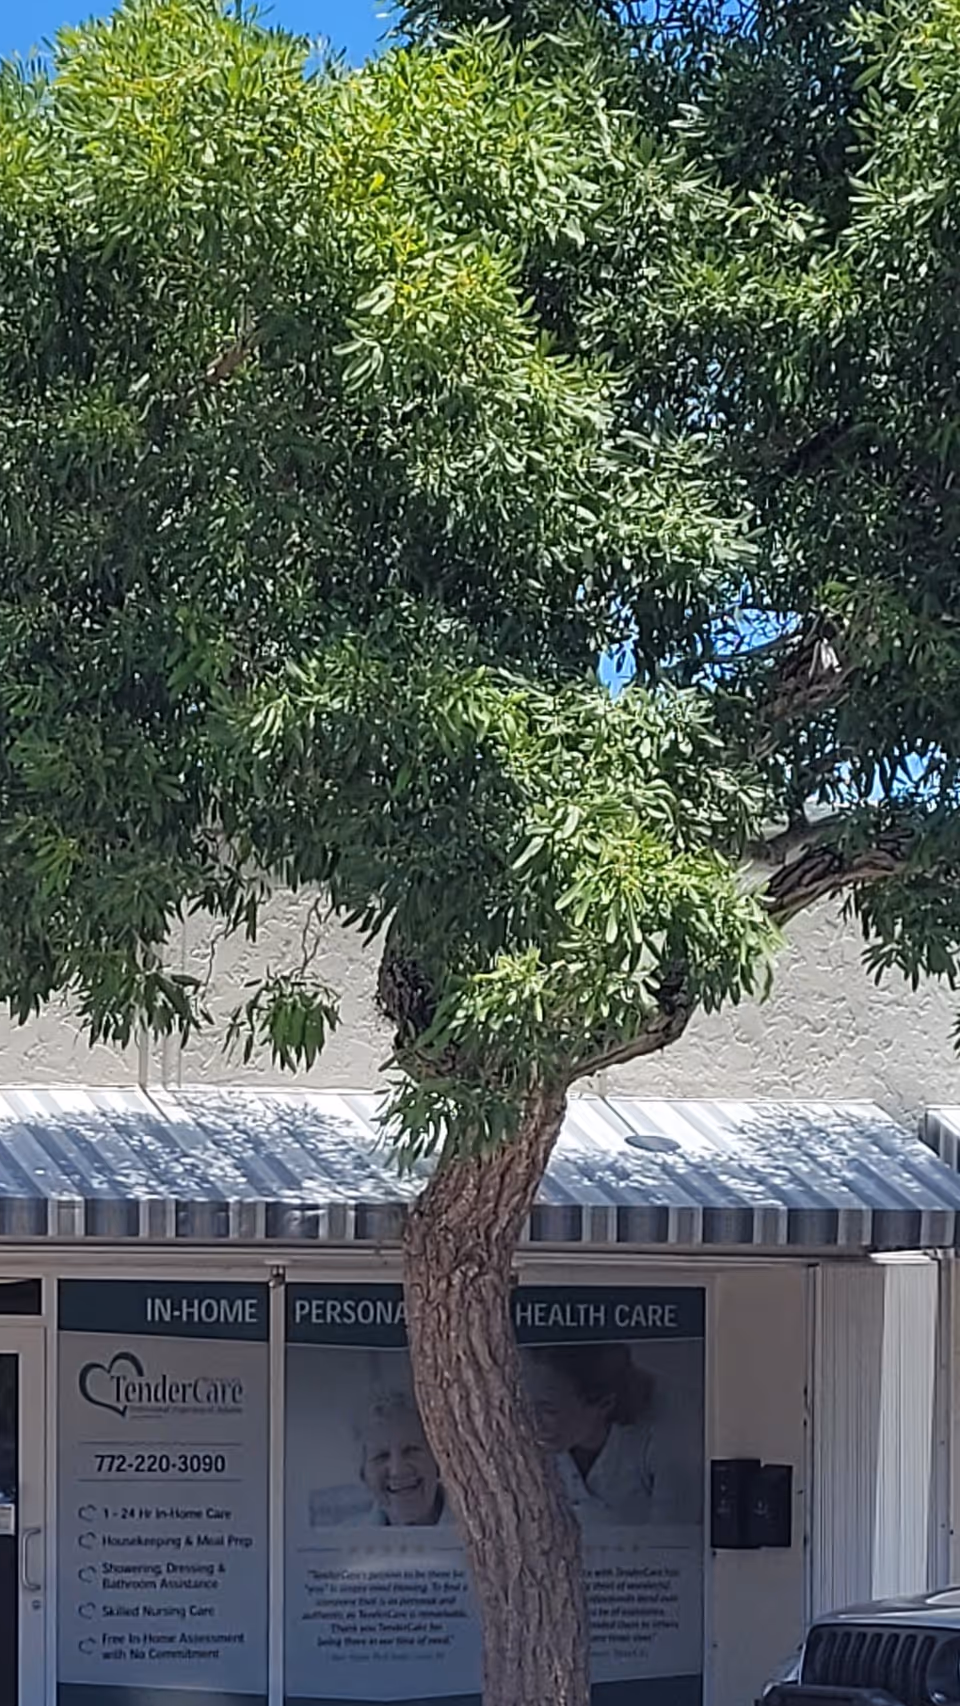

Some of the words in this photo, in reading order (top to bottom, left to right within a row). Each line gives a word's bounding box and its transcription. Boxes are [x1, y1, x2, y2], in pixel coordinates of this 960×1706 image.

[146, 1298, 258, 1323] IN-HOME
[516, 1303, 605, 1328] HEALTH
[615, 1304, 678, 1327] CARE
[110, 1374, 244, 1404] TenderCare
[95, 1454, 226, 1473] 772-220-3090
[121, 1508, 135, 1519] 24
[156, 1508, 203, 1520] In-Home
[206, 1508, 232, 1520] Care
[102, 1535, 182, 1550] Housekeeping
[184, 1536, 193, 1547] &
[197, 1535, 225, 1547] Meal
[227, 1535, 253, 1549] Prep
[166, 1563, 215, 1576] Dressing
[218, 1564, 226, 1573] &
[102, 1578, 157, 1590] Bathroom
[160, 1578, 219, 1590] Assistance
[102, 1605, 139, 1617] Skilled
[143, 1605, 186, 1619] Nursing
[189, 1605, 215, 1617] Care
[102, 1632, 126, 1645] Free
[179, 1633, 245, 1645] Assessment
[102, 1649, 127, 1660] with
[130, 1649, 145, 1660] No
[148, 1649, 219, 1661] Commitment
